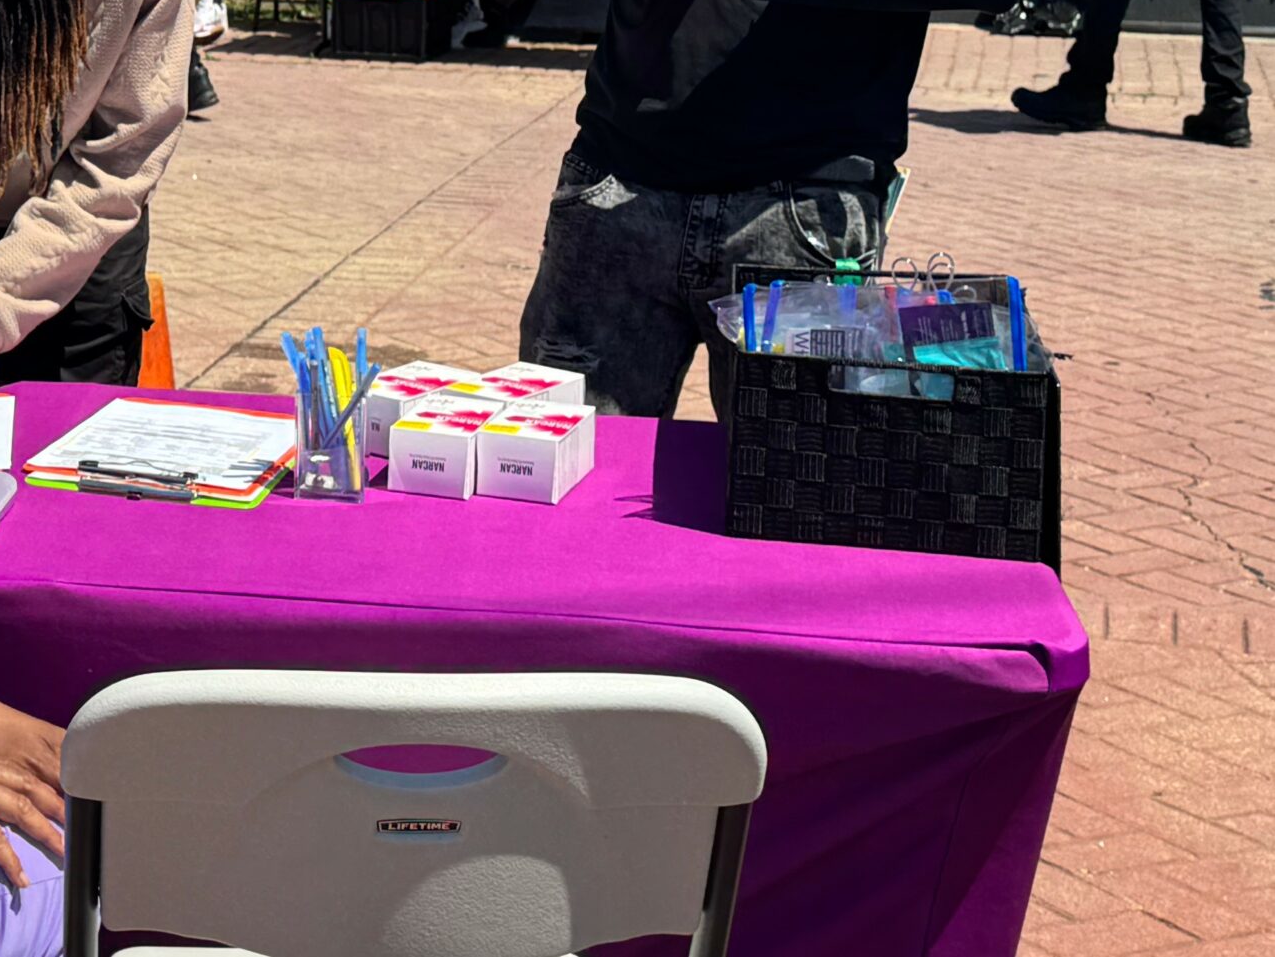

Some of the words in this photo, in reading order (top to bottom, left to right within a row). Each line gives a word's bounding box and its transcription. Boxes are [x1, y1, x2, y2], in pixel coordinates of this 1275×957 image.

[411, 458, 445, 472] NARCAN
[500, 462, 533, 476] NARCAN
[387, 822, 451, 831] LIFETIME
